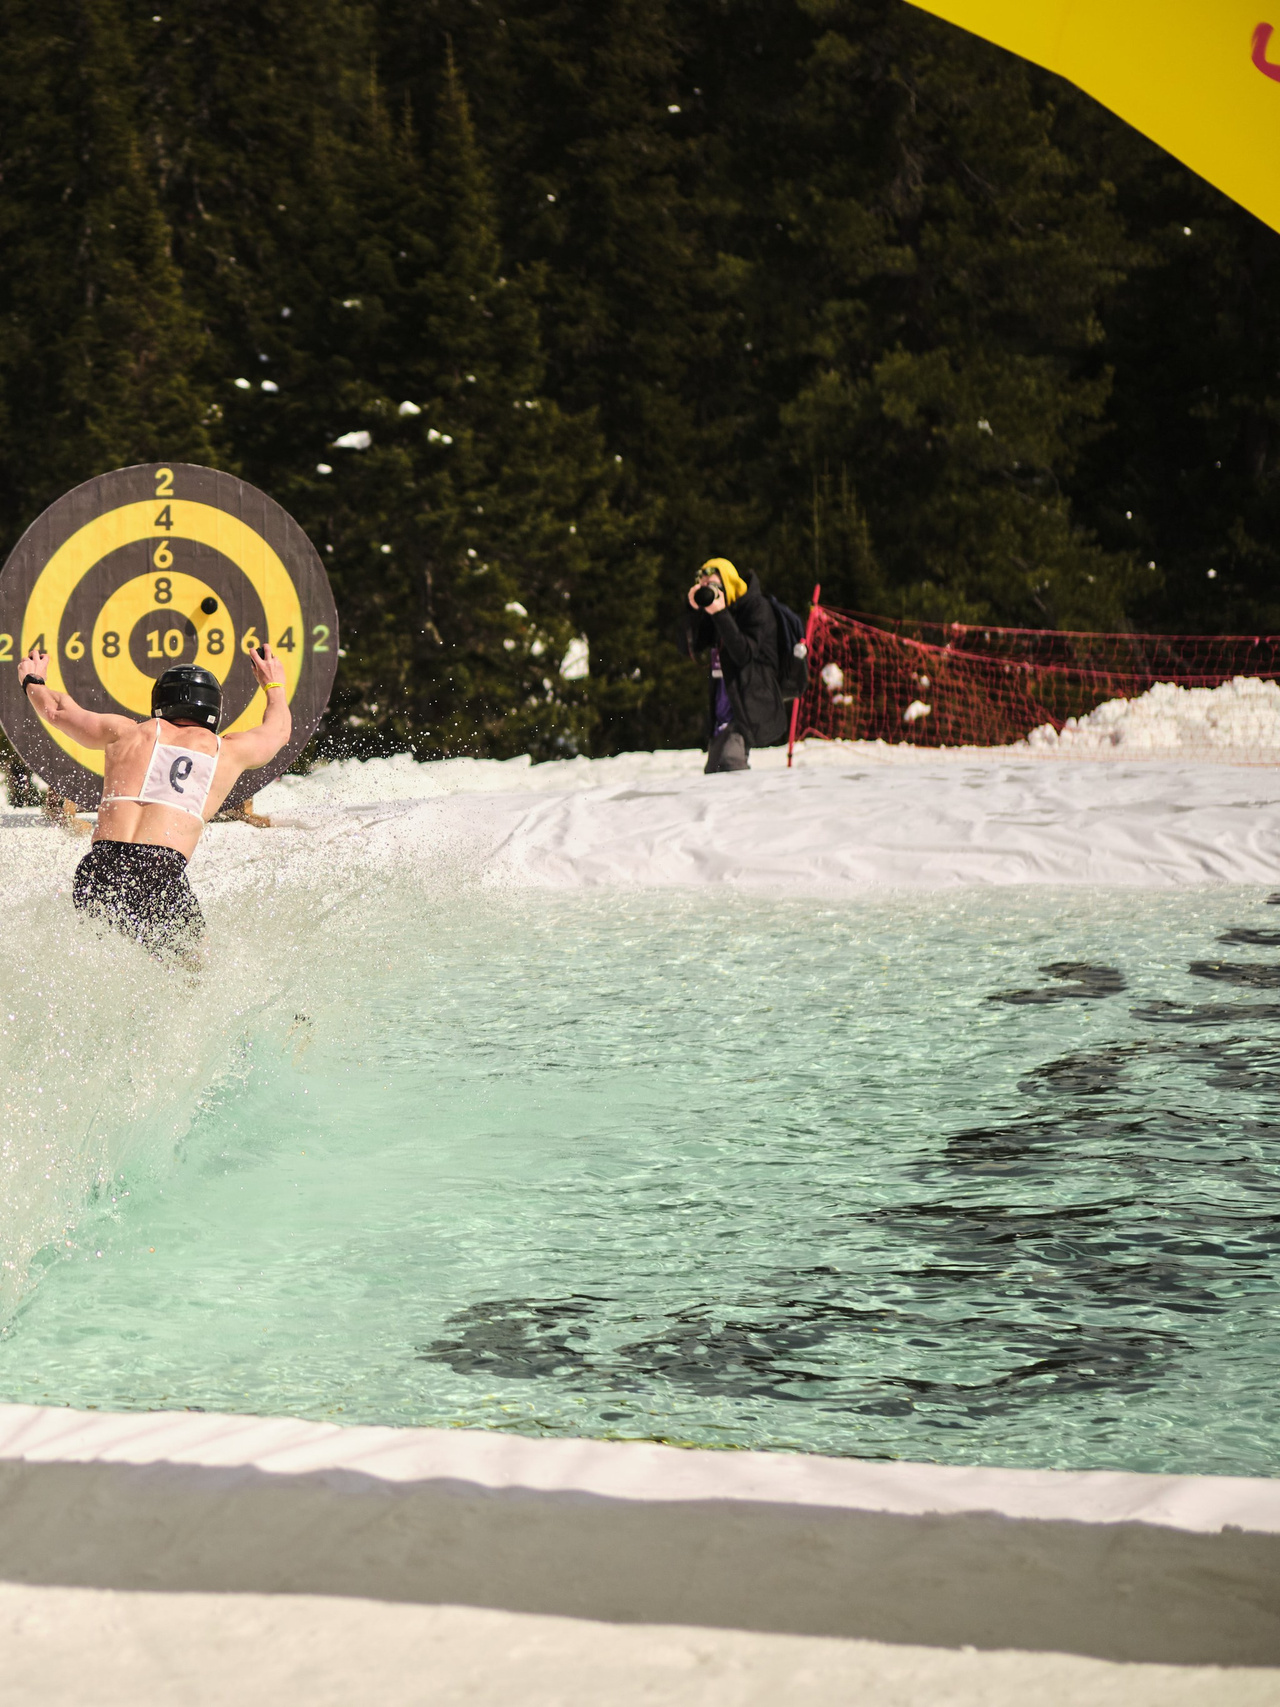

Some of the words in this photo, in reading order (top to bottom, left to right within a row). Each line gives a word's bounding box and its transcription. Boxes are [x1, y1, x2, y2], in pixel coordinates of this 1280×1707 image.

[155, 468, 174, 496] 2
[154, 504, 174, 531] 4
[153, 540, 173, 568] 6
[153, 577, 173, 604] 8
[65, 631, 85, 660] 6
[101, 631, 121, 658] 8
[146, 629, 184, 657] 10
[206, 628, 226, 655] 8
[241, 626, 261, 653] 6
[276, 626, 296, 652] 4
[312, 625, 330, 652] 2
